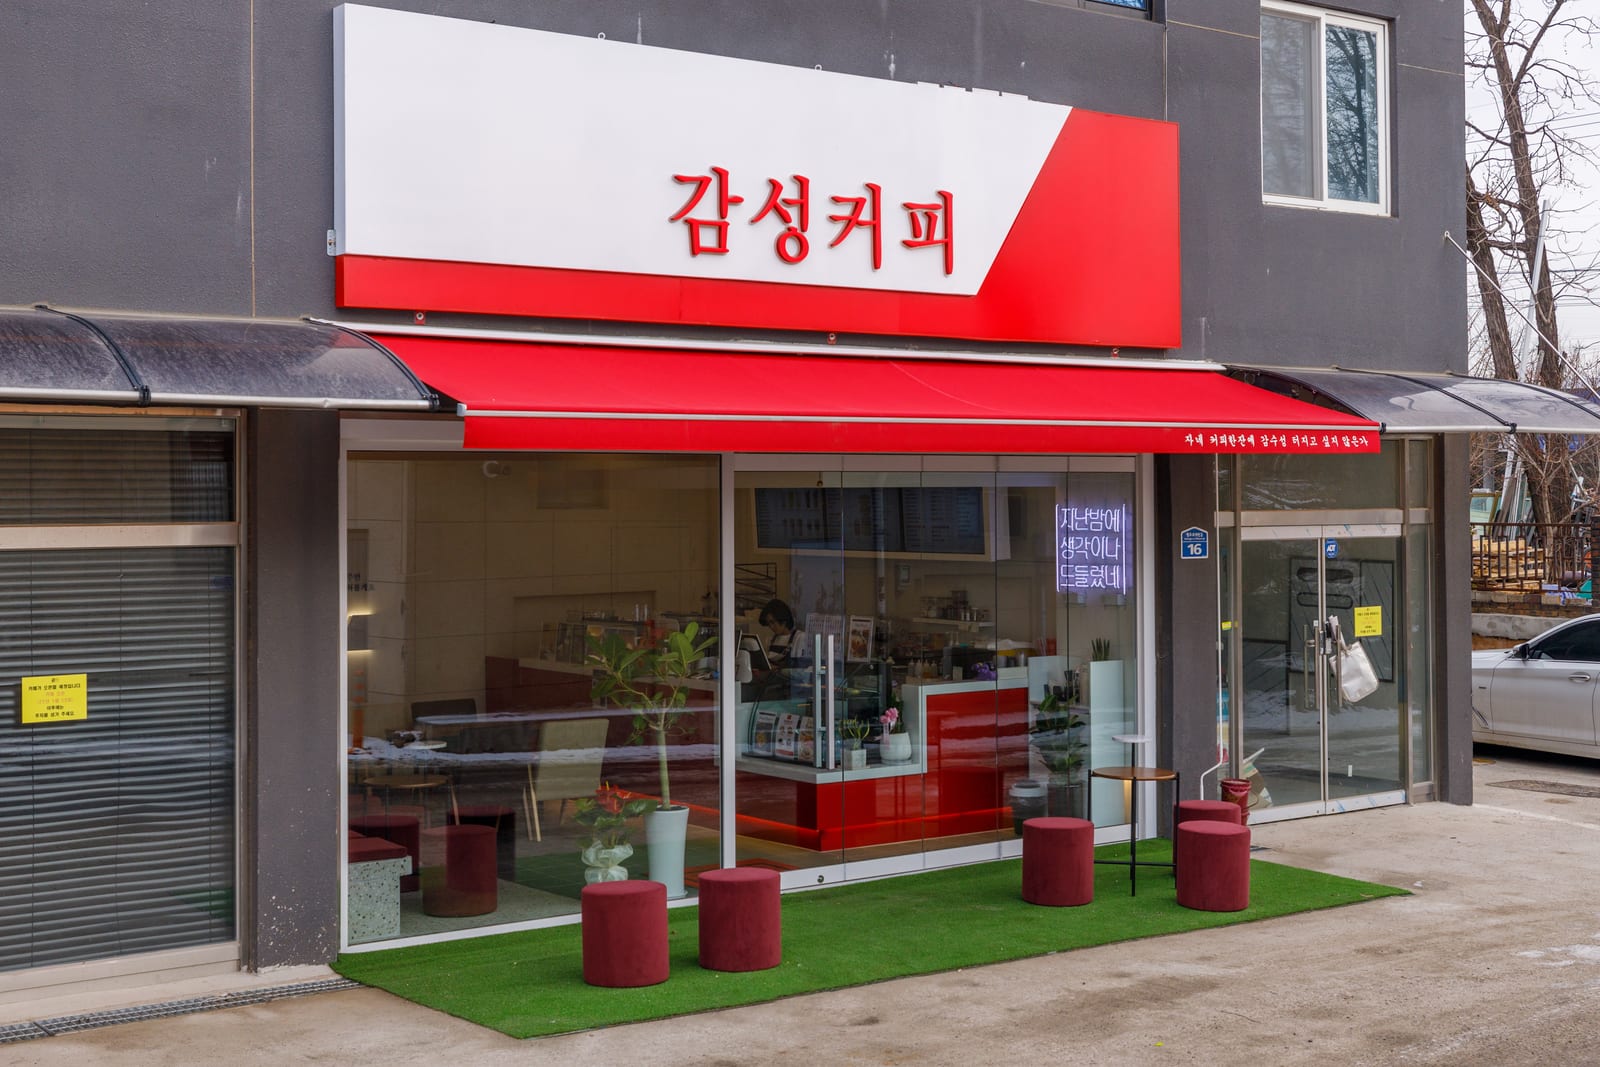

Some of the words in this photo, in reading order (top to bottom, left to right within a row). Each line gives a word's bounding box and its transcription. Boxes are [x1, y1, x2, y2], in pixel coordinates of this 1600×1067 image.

[669, 165, 953, 275] 감성커피
[1185, 433, 1204, 448] 자네
[1260, 434, 1287, 448] 감수성
[1060, 507, 1121, 533] 지난밤에
[1060, 535, 1121, 560] 생각이나
[1187, 543, 1202, 555] 16
